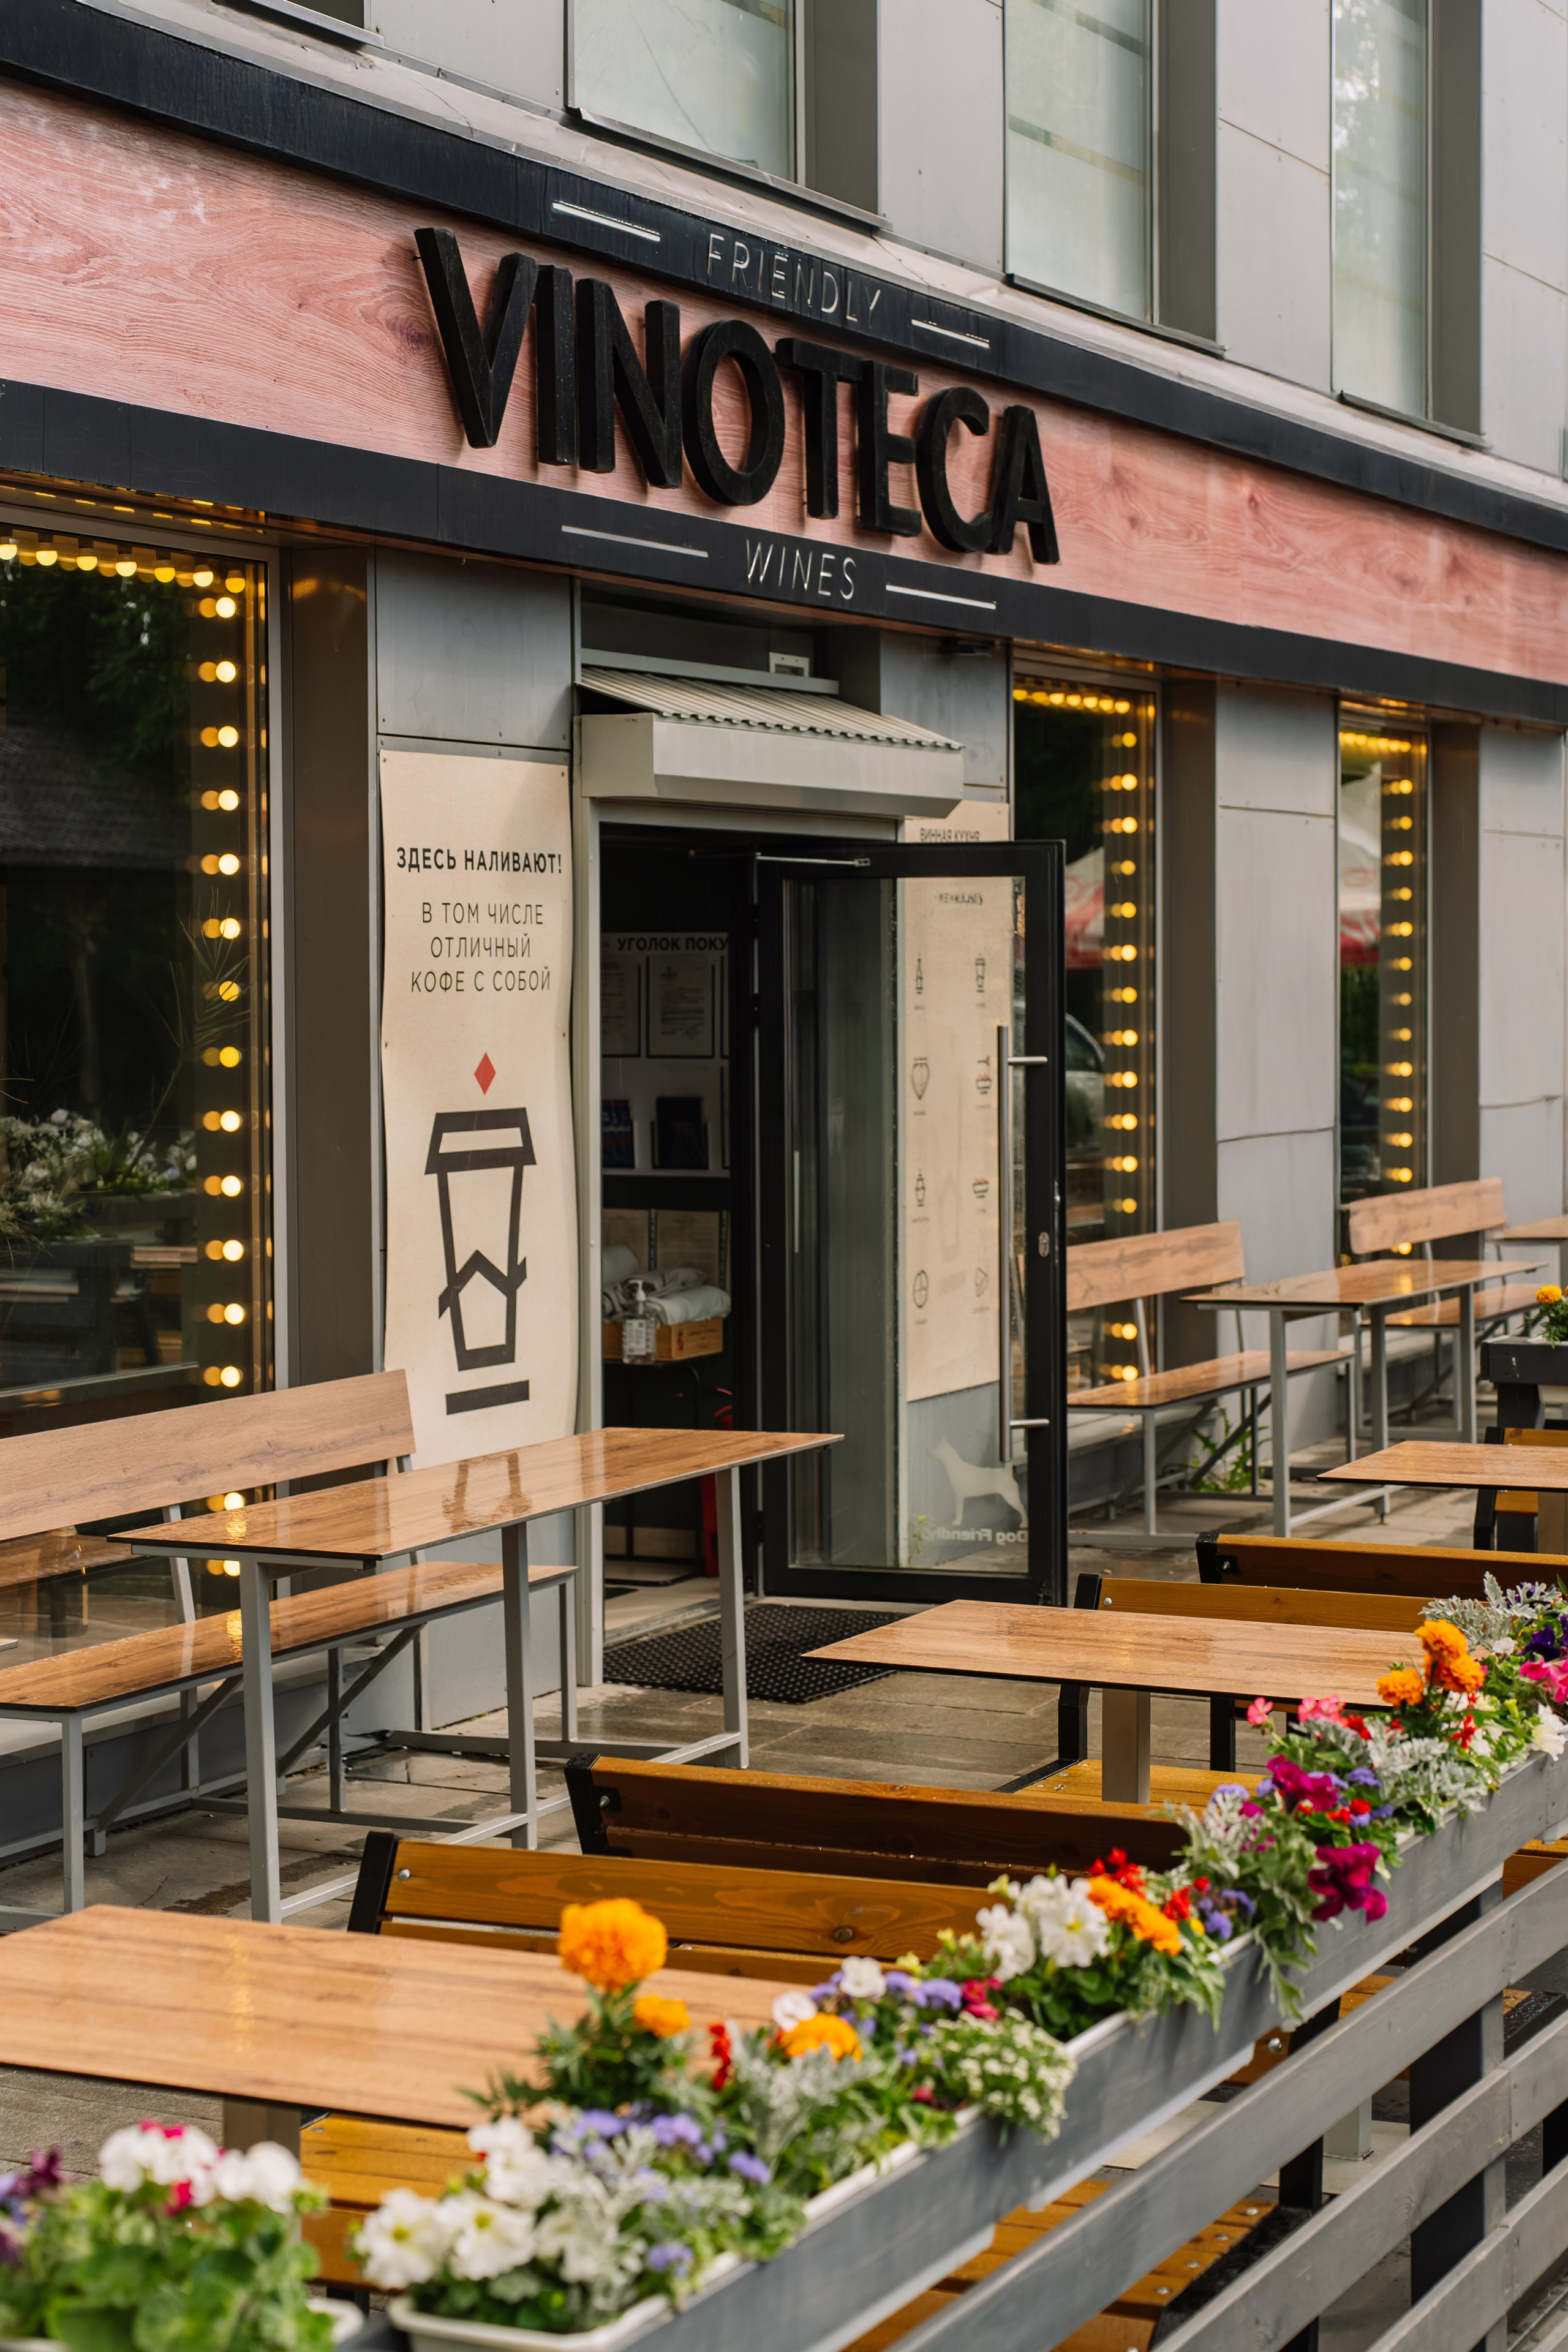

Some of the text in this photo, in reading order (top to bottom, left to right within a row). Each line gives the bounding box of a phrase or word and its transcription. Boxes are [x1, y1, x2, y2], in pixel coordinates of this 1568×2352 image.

[707, 233, 881, 328] FRIENDLY
[413, 227, 1060, 564] VINOTECA
[745, 538, 857, 601] WINES
[397, 847, 562, 873] ЗДЕСЬ НАЛИВАЮТ!
[422, 902, 543, 925] В ТОМ ЧИСЛЕ
[431, 932, 530, 958] ОТЛИЧНЫЙ
[617, 937, 682, 951] УГОЛОК
[411, 965, 550, 992] КОФЕ С СОБОЙ
